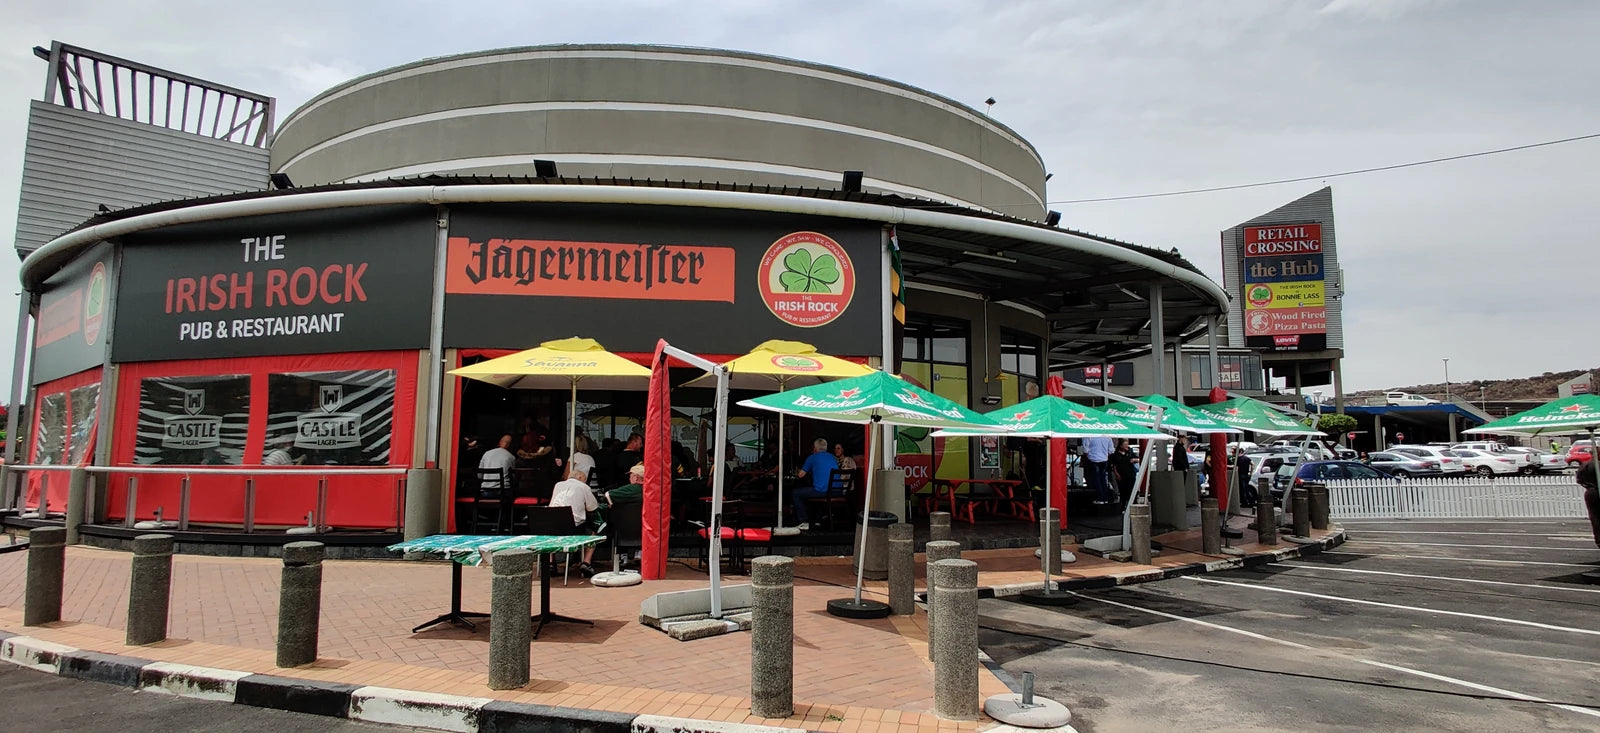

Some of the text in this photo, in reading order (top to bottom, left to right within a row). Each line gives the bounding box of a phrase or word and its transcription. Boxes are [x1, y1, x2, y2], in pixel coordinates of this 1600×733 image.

[1258, 227, 1309, 240] RETAIL
[241, 235, 286, 262] THE
[1247, 240, 1319, 254] CROSSING
[1250, 259, 1319, 278] the Hub
[165, 263, 368, 314] IRISH ROCK
[774, 301, 838, 312] IRISH ROCK
[782, 312, 792, 320] PUB
[799, 312, 831, 323] RESTAURANT
[1272, 312, 1298, 320] Wood
[1301, 311, 1326, 319] Fired
[180, 313, 345, 341] PUB & RESTAURANT
[1219, 373, 1239, 381] SALE
[792, 394, 865, 409] Heineken
[1518, 411, 1600, 423] Heineke
[167, 422, 217, 438] CASTLE
[300, 420, 356, 438] CASTLE
